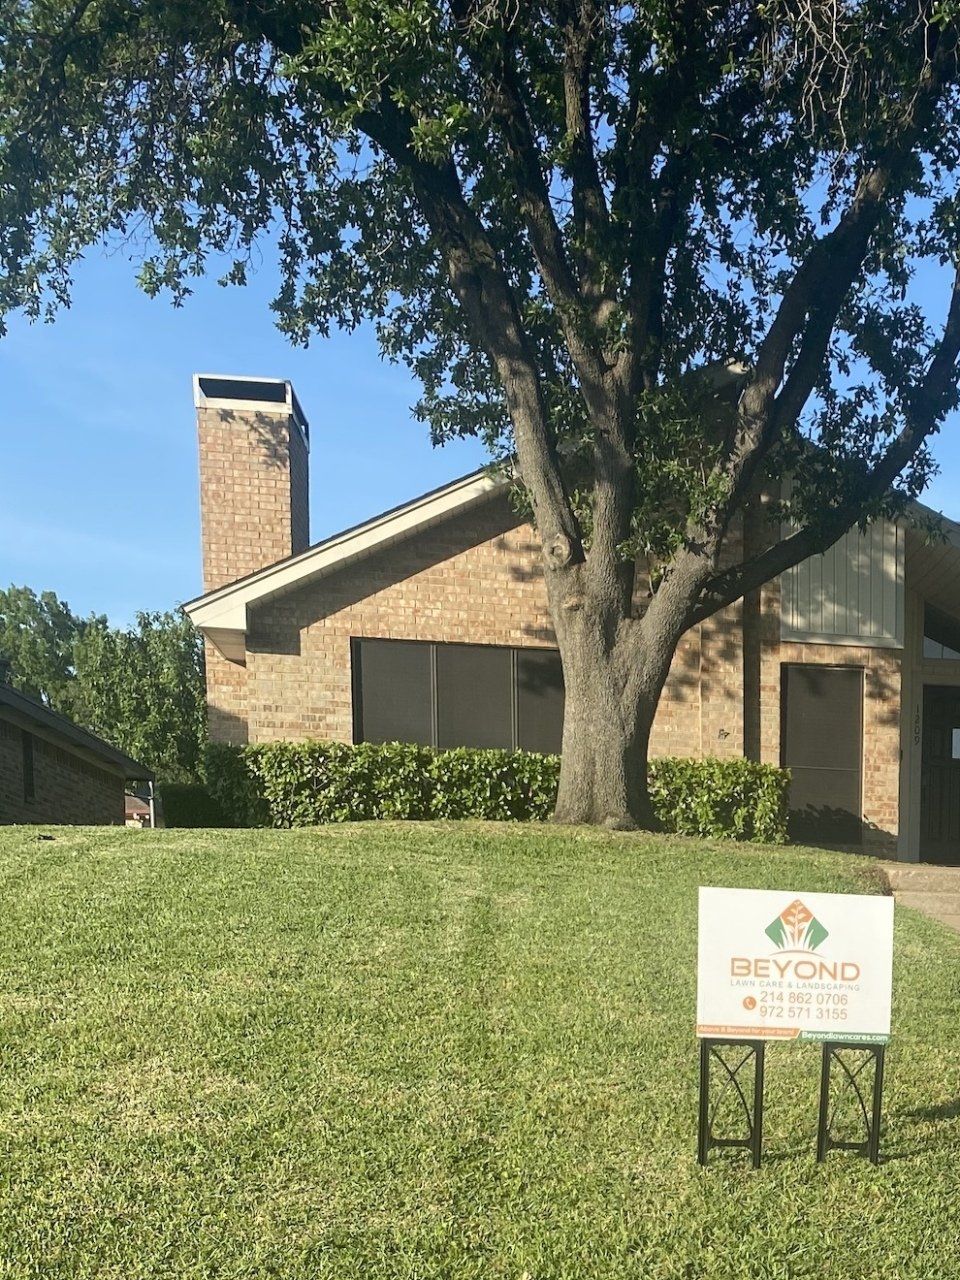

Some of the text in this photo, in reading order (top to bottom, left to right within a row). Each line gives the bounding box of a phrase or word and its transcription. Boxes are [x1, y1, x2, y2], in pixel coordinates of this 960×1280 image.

[730, 957, 861, 982] BEYOND
[730, 979, 755, 987] LAWN
[759, 980, 784, 988] CARE
[796, 982, 861, 991] LANDSCAPING
[759, 991, 848, 1006] 214 862 0706
[759, 1006, 848, 1020] 972 571 3155
[801, 1031, 889, 1041] Beyondlawncares.com
